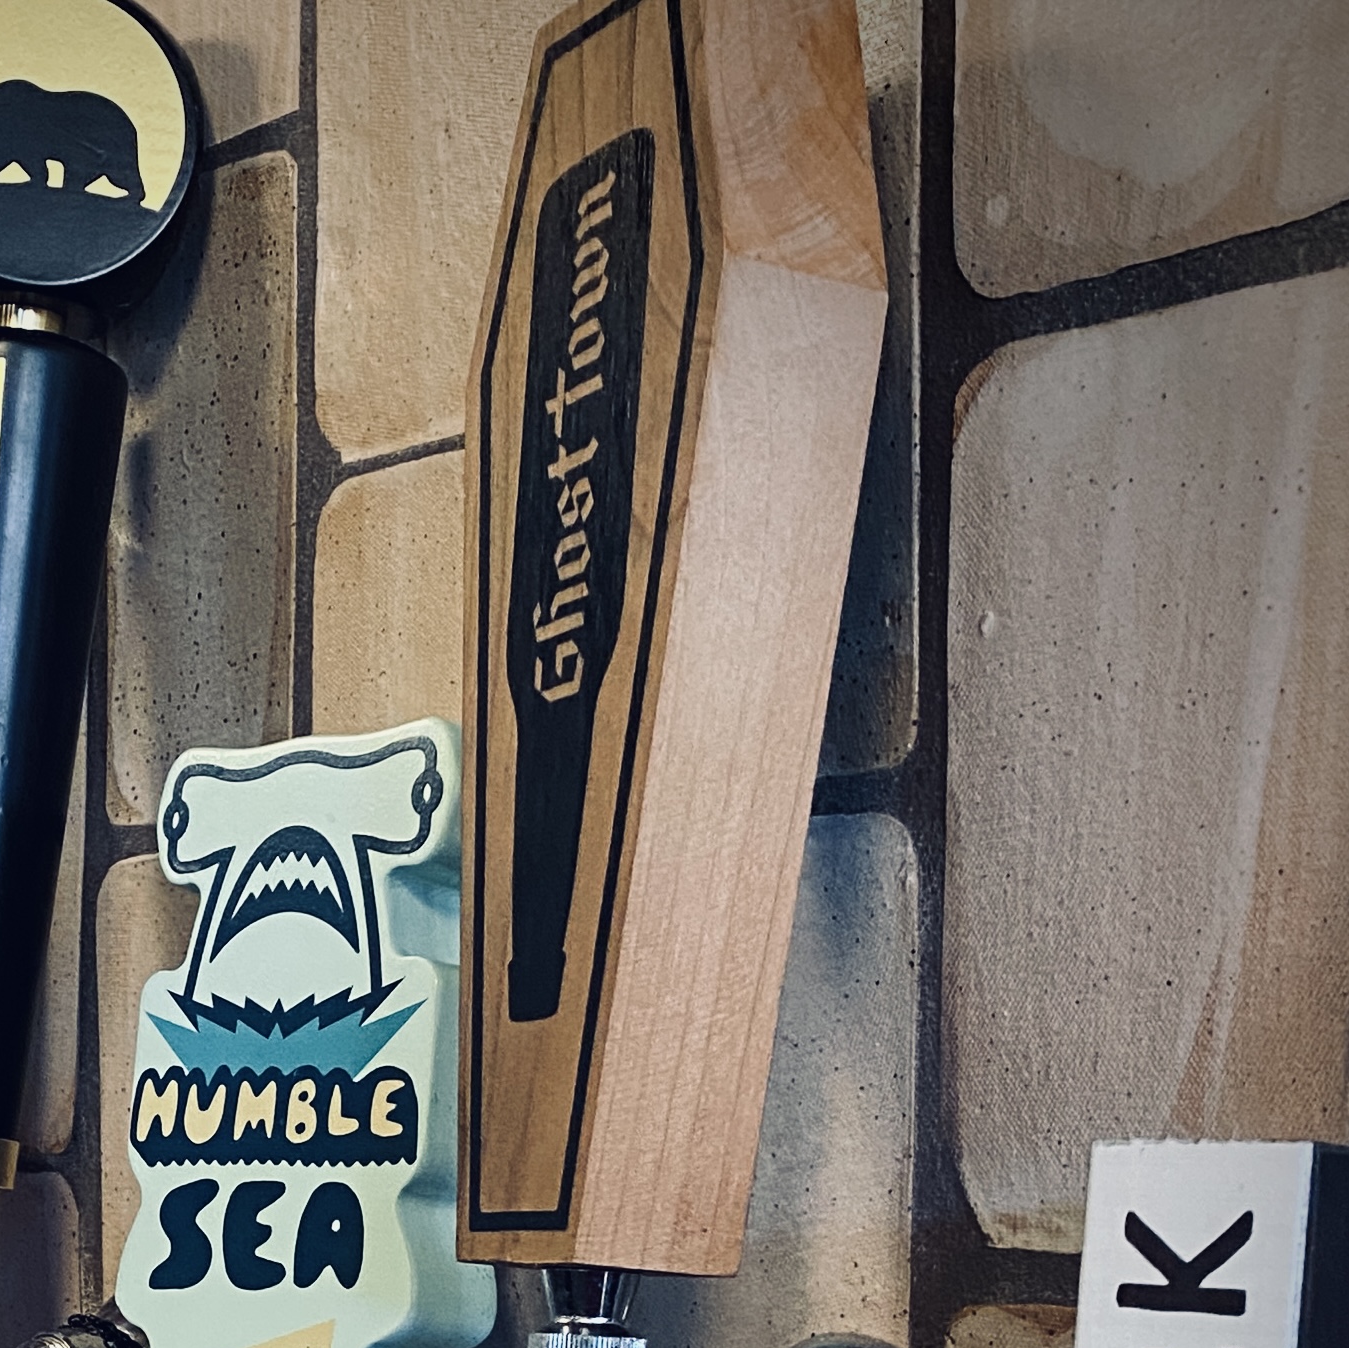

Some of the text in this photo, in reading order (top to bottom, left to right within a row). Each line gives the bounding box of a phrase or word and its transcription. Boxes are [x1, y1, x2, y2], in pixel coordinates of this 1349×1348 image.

[534, 436, 599, 702] Ghost
[135, 1077, 406, 1145] HUMBLE
[148, 1178, 365, 1291] SEA
